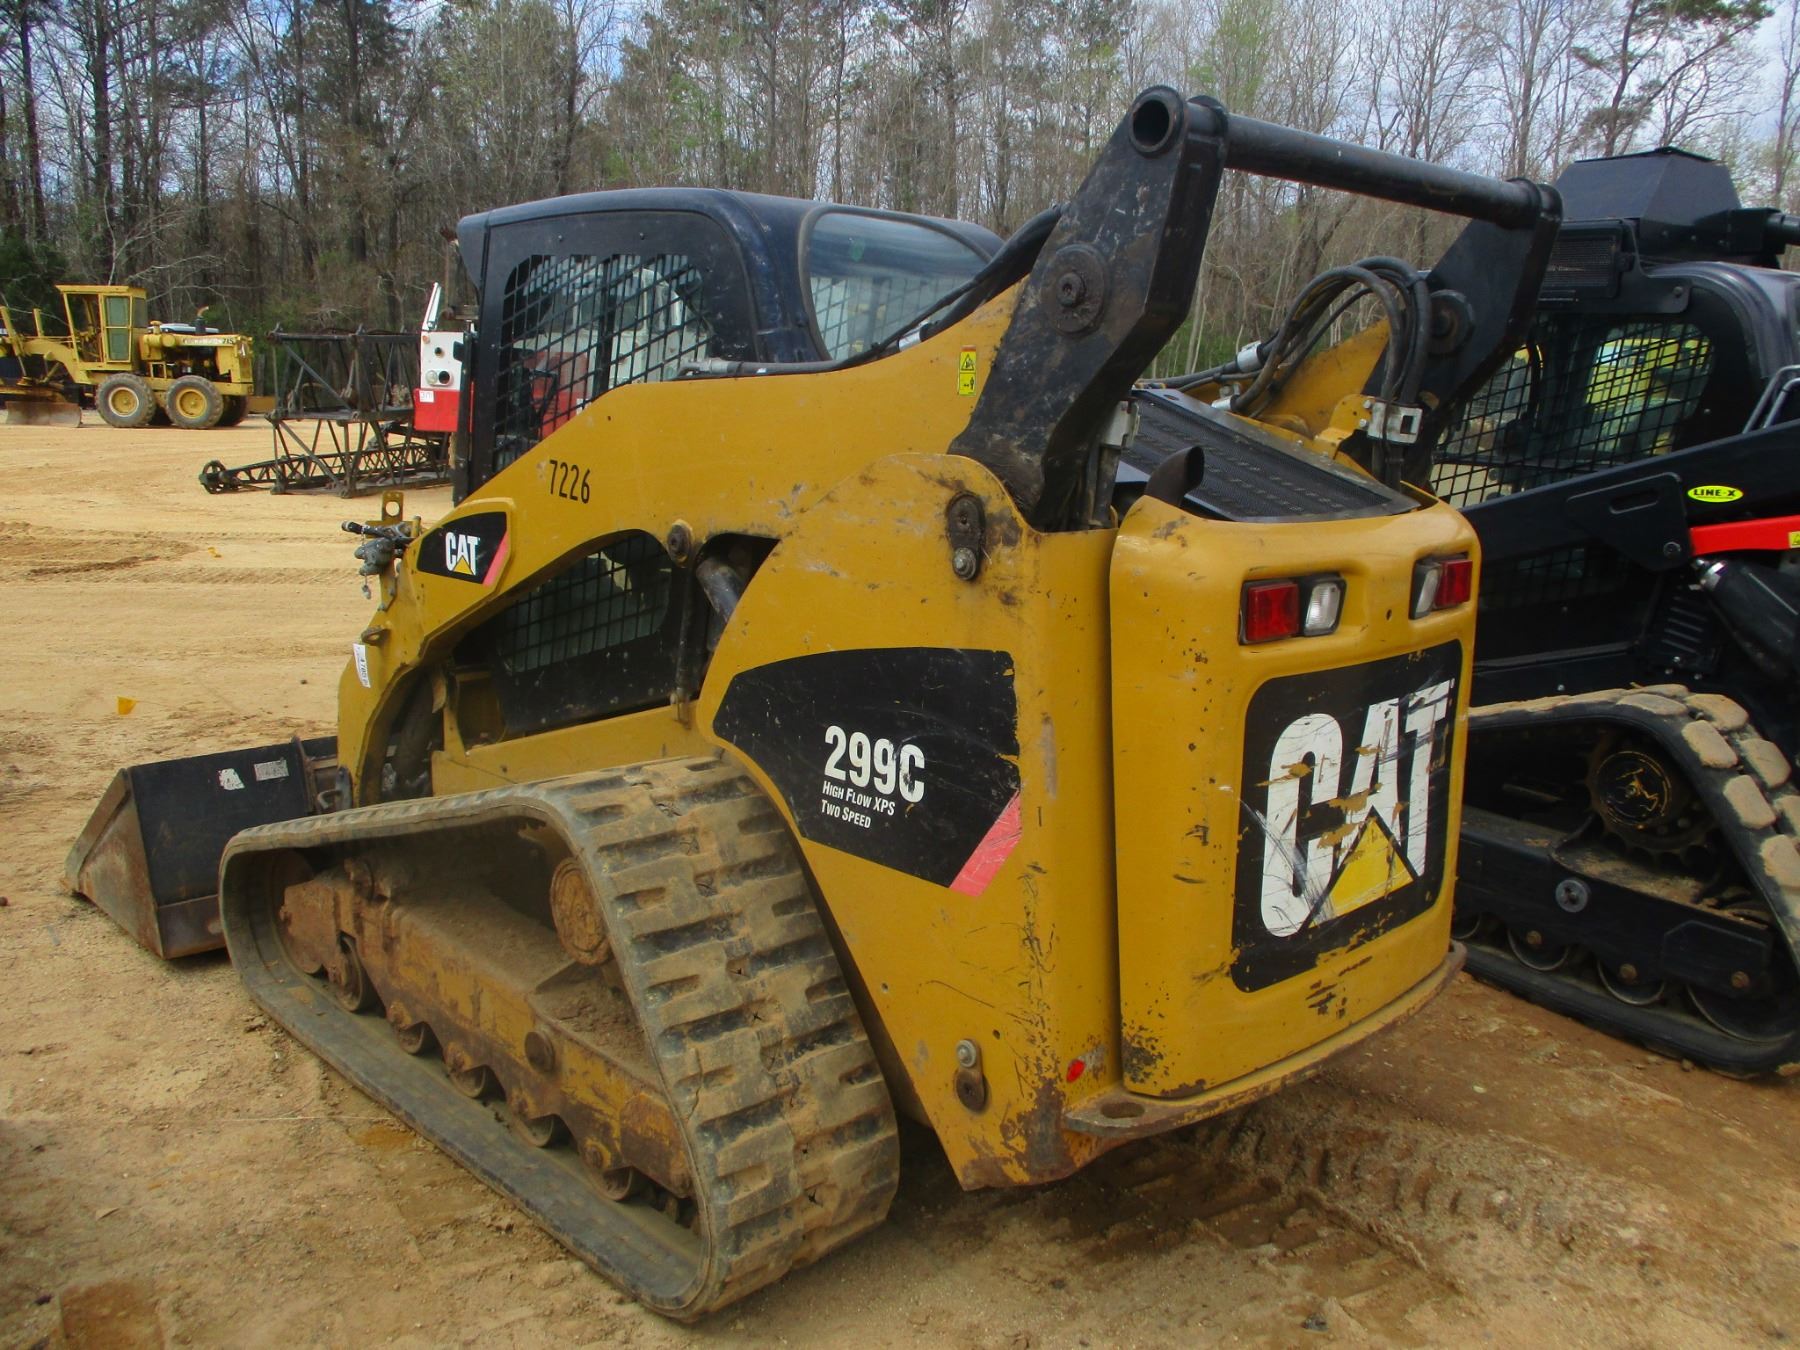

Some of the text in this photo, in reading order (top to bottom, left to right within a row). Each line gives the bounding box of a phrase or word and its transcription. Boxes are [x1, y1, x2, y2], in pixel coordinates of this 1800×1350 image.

[549, 459, 590, 504] 7226
[445, 531, 480, 576] CAT
[824, 725, 925, 803] 299C
[873, 796, 896, 816] XPS
[1260, 678, 1455, 938] CAT
